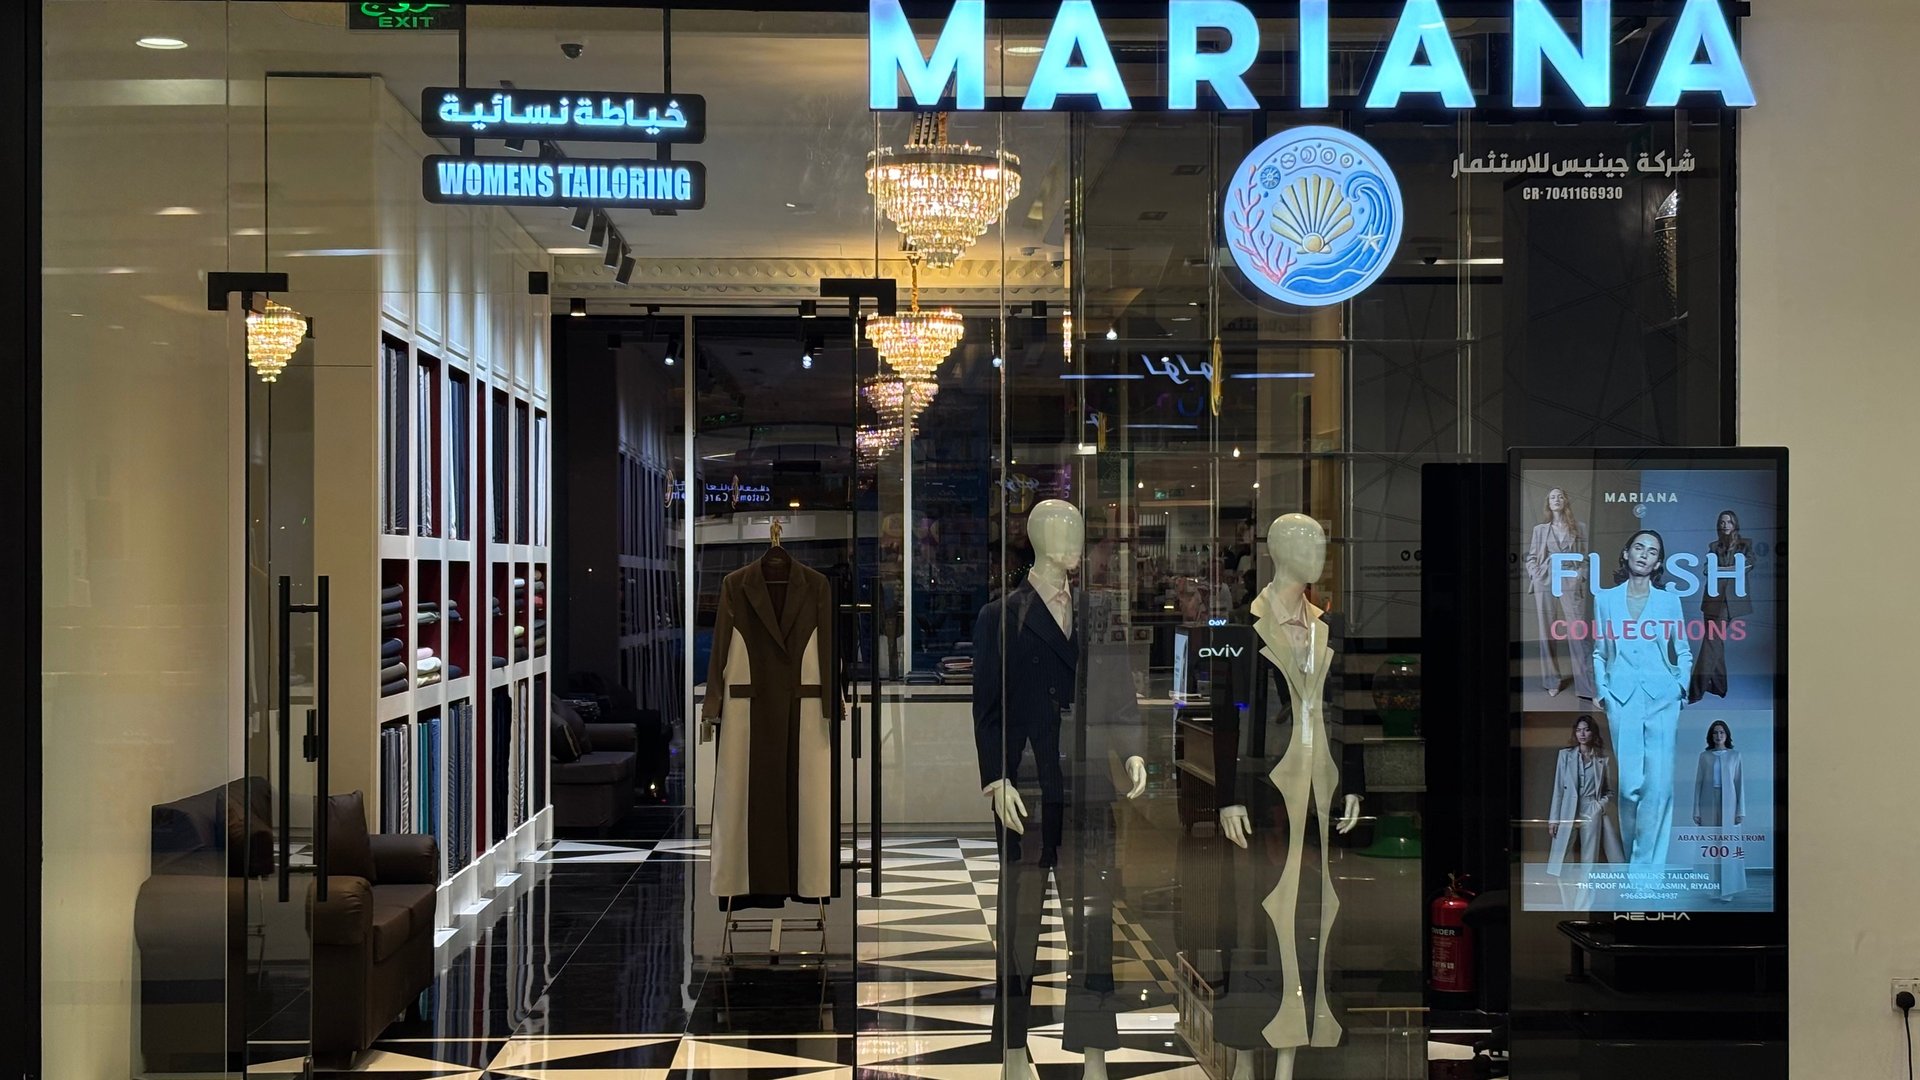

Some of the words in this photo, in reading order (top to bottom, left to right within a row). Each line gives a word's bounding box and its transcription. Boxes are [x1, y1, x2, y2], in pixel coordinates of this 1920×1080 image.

[379, 17, 433, 27] EXIT
[868, 0, 1757, 110] MARIANA
[439, 94, 570, 130] نسائية
[574, 98, 688, 135] خياطة
[1451, 150, 1549, 179] للاستثمار
[1553, 152, 1630, 178] جينيس
[1637, 149, 1695, 178] شركة
[437, 162, 554, 198] WOMENS
[558, 165, 691, 201] TAILORING
[1604, 492, 1678, 503] MARIANA
[1550, 552, 1747, 597] FLSH
[1551, 619, 1746, 641] COLLECTIONS
[1701, 845, 1729, 858] 700
[1588, 872, 1625, 880] MARIANA
[1668, 872, 1710, 880] TAILORING
